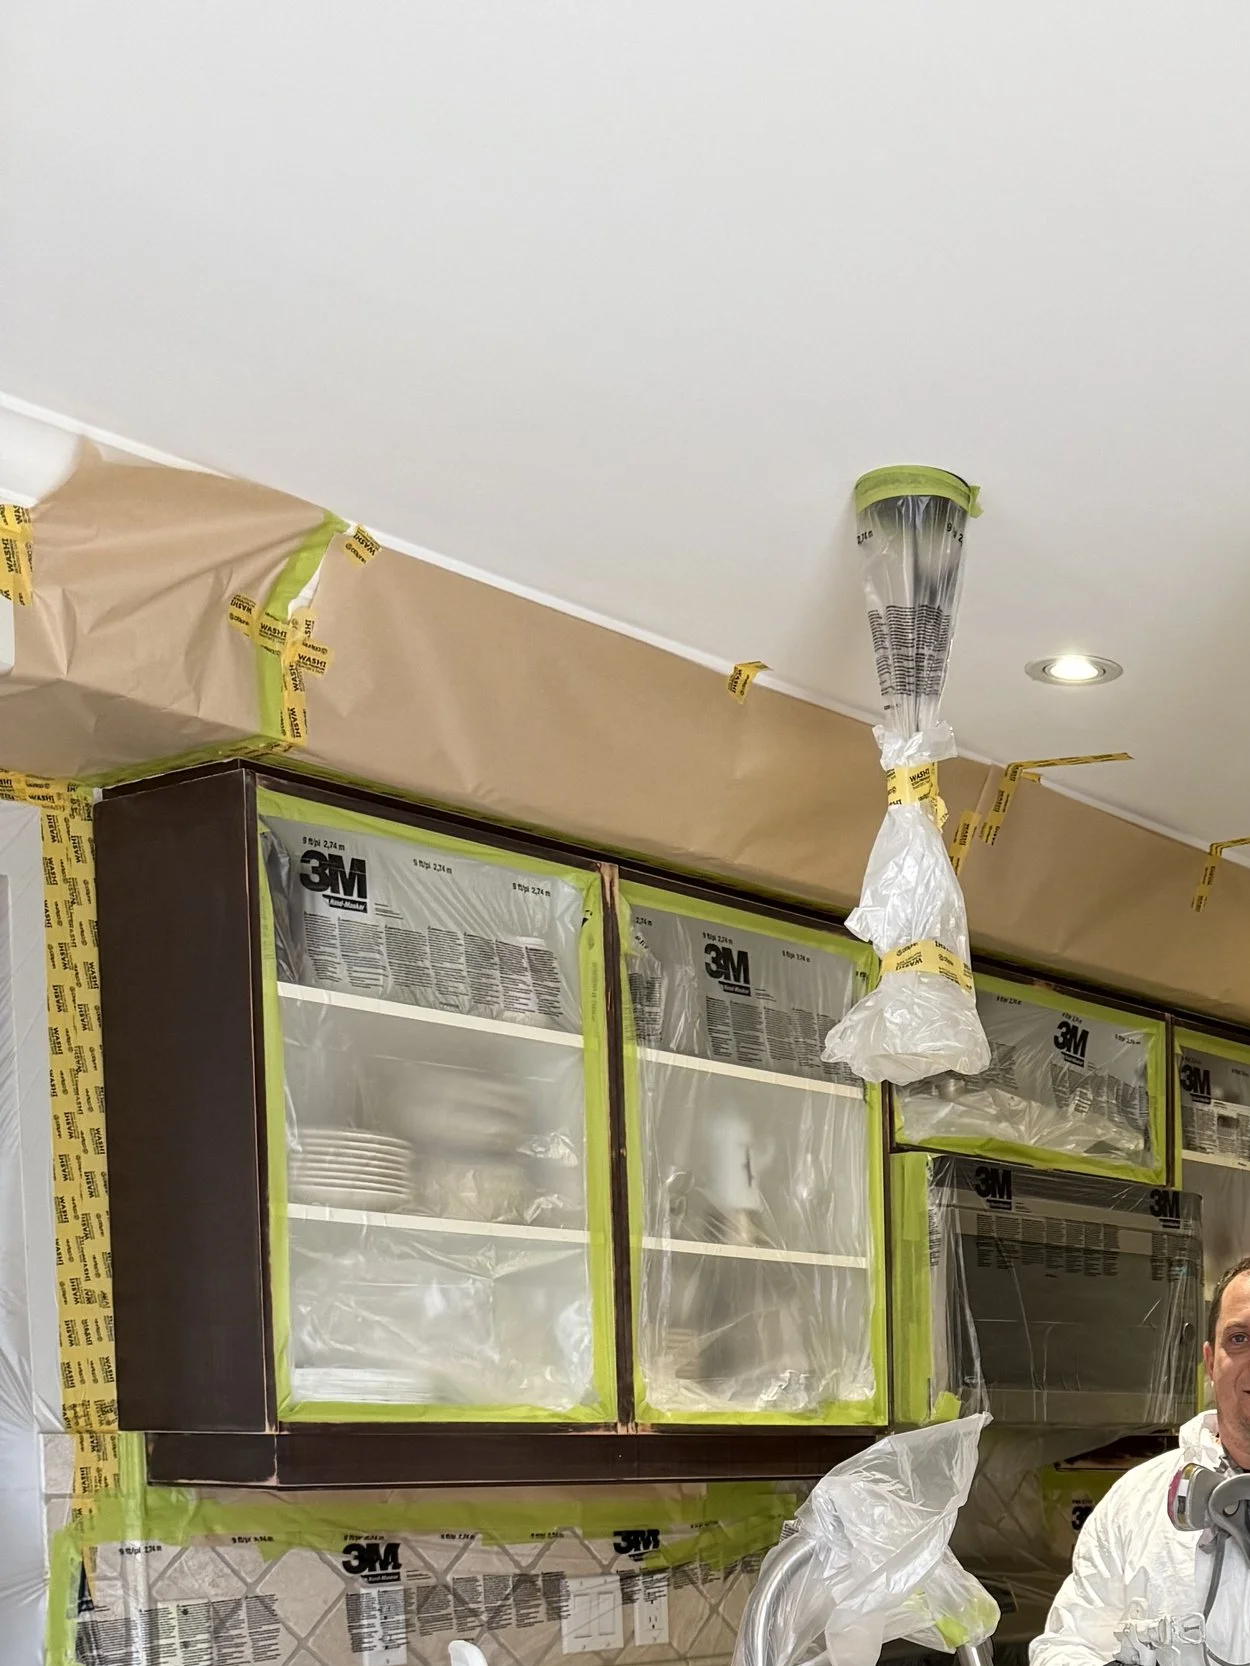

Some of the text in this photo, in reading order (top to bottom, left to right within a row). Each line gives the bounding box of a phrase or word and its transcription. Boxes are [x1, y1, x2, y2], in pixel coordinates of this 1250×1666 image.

[2, 538, 14, 573] WASHI
[353, 533, 376, 556] WASHI
[260, 622, 287, 638] WASHI
[298, 653, 327, 668] WASHI
[288, 707, 301, 739] WASHI
[47, 815, 57, 843] WASHI
[323, 840, 338, 850] 2,74
[338, 843, 345, 851] m
[300, 850, 367, 899] 3M
[433, 862, 446, 874] 2,74
[531, 886, 544, 896] 2,74
[704, 943, 750, 985] 3M
[1054, 1021, 1089, 1058] 3M
[1180, 1064, 1211, 1096] 3M
[974, 1166, 1012, 1200] 3M
[1150, 1188, 1181, 1218] 3M
[342, 1543, 402, 1574] 3M
